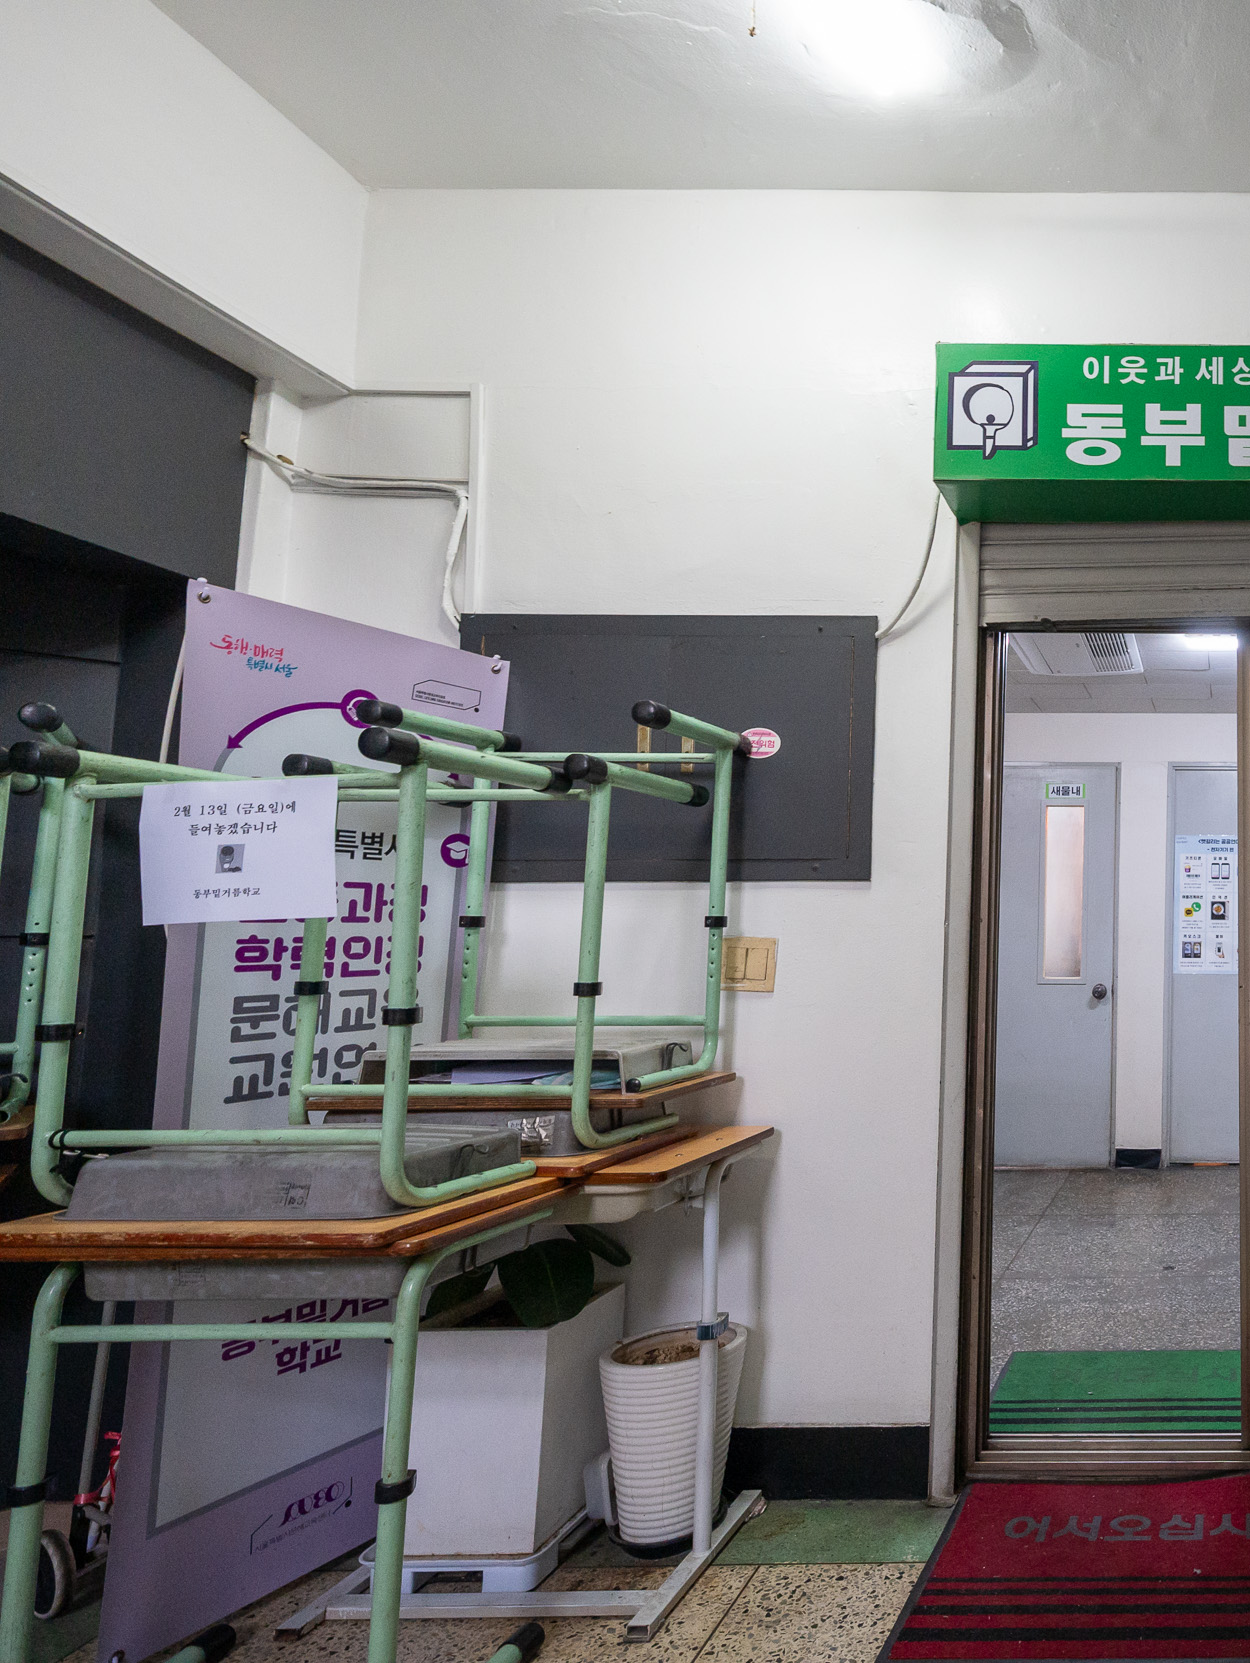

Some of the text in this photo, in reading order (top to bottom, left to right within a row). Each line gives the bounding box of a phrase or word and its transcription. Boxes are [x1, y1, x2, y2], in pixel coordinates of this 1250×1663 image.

[1082, 355, 1184, 385] 이웃과
[245, 656, 299, 678] 특별시 서울
[173, 800, 297, 818] 2월 13일 (금요일)에
[188, 820, 278, 836] 들여놓겠습니다
